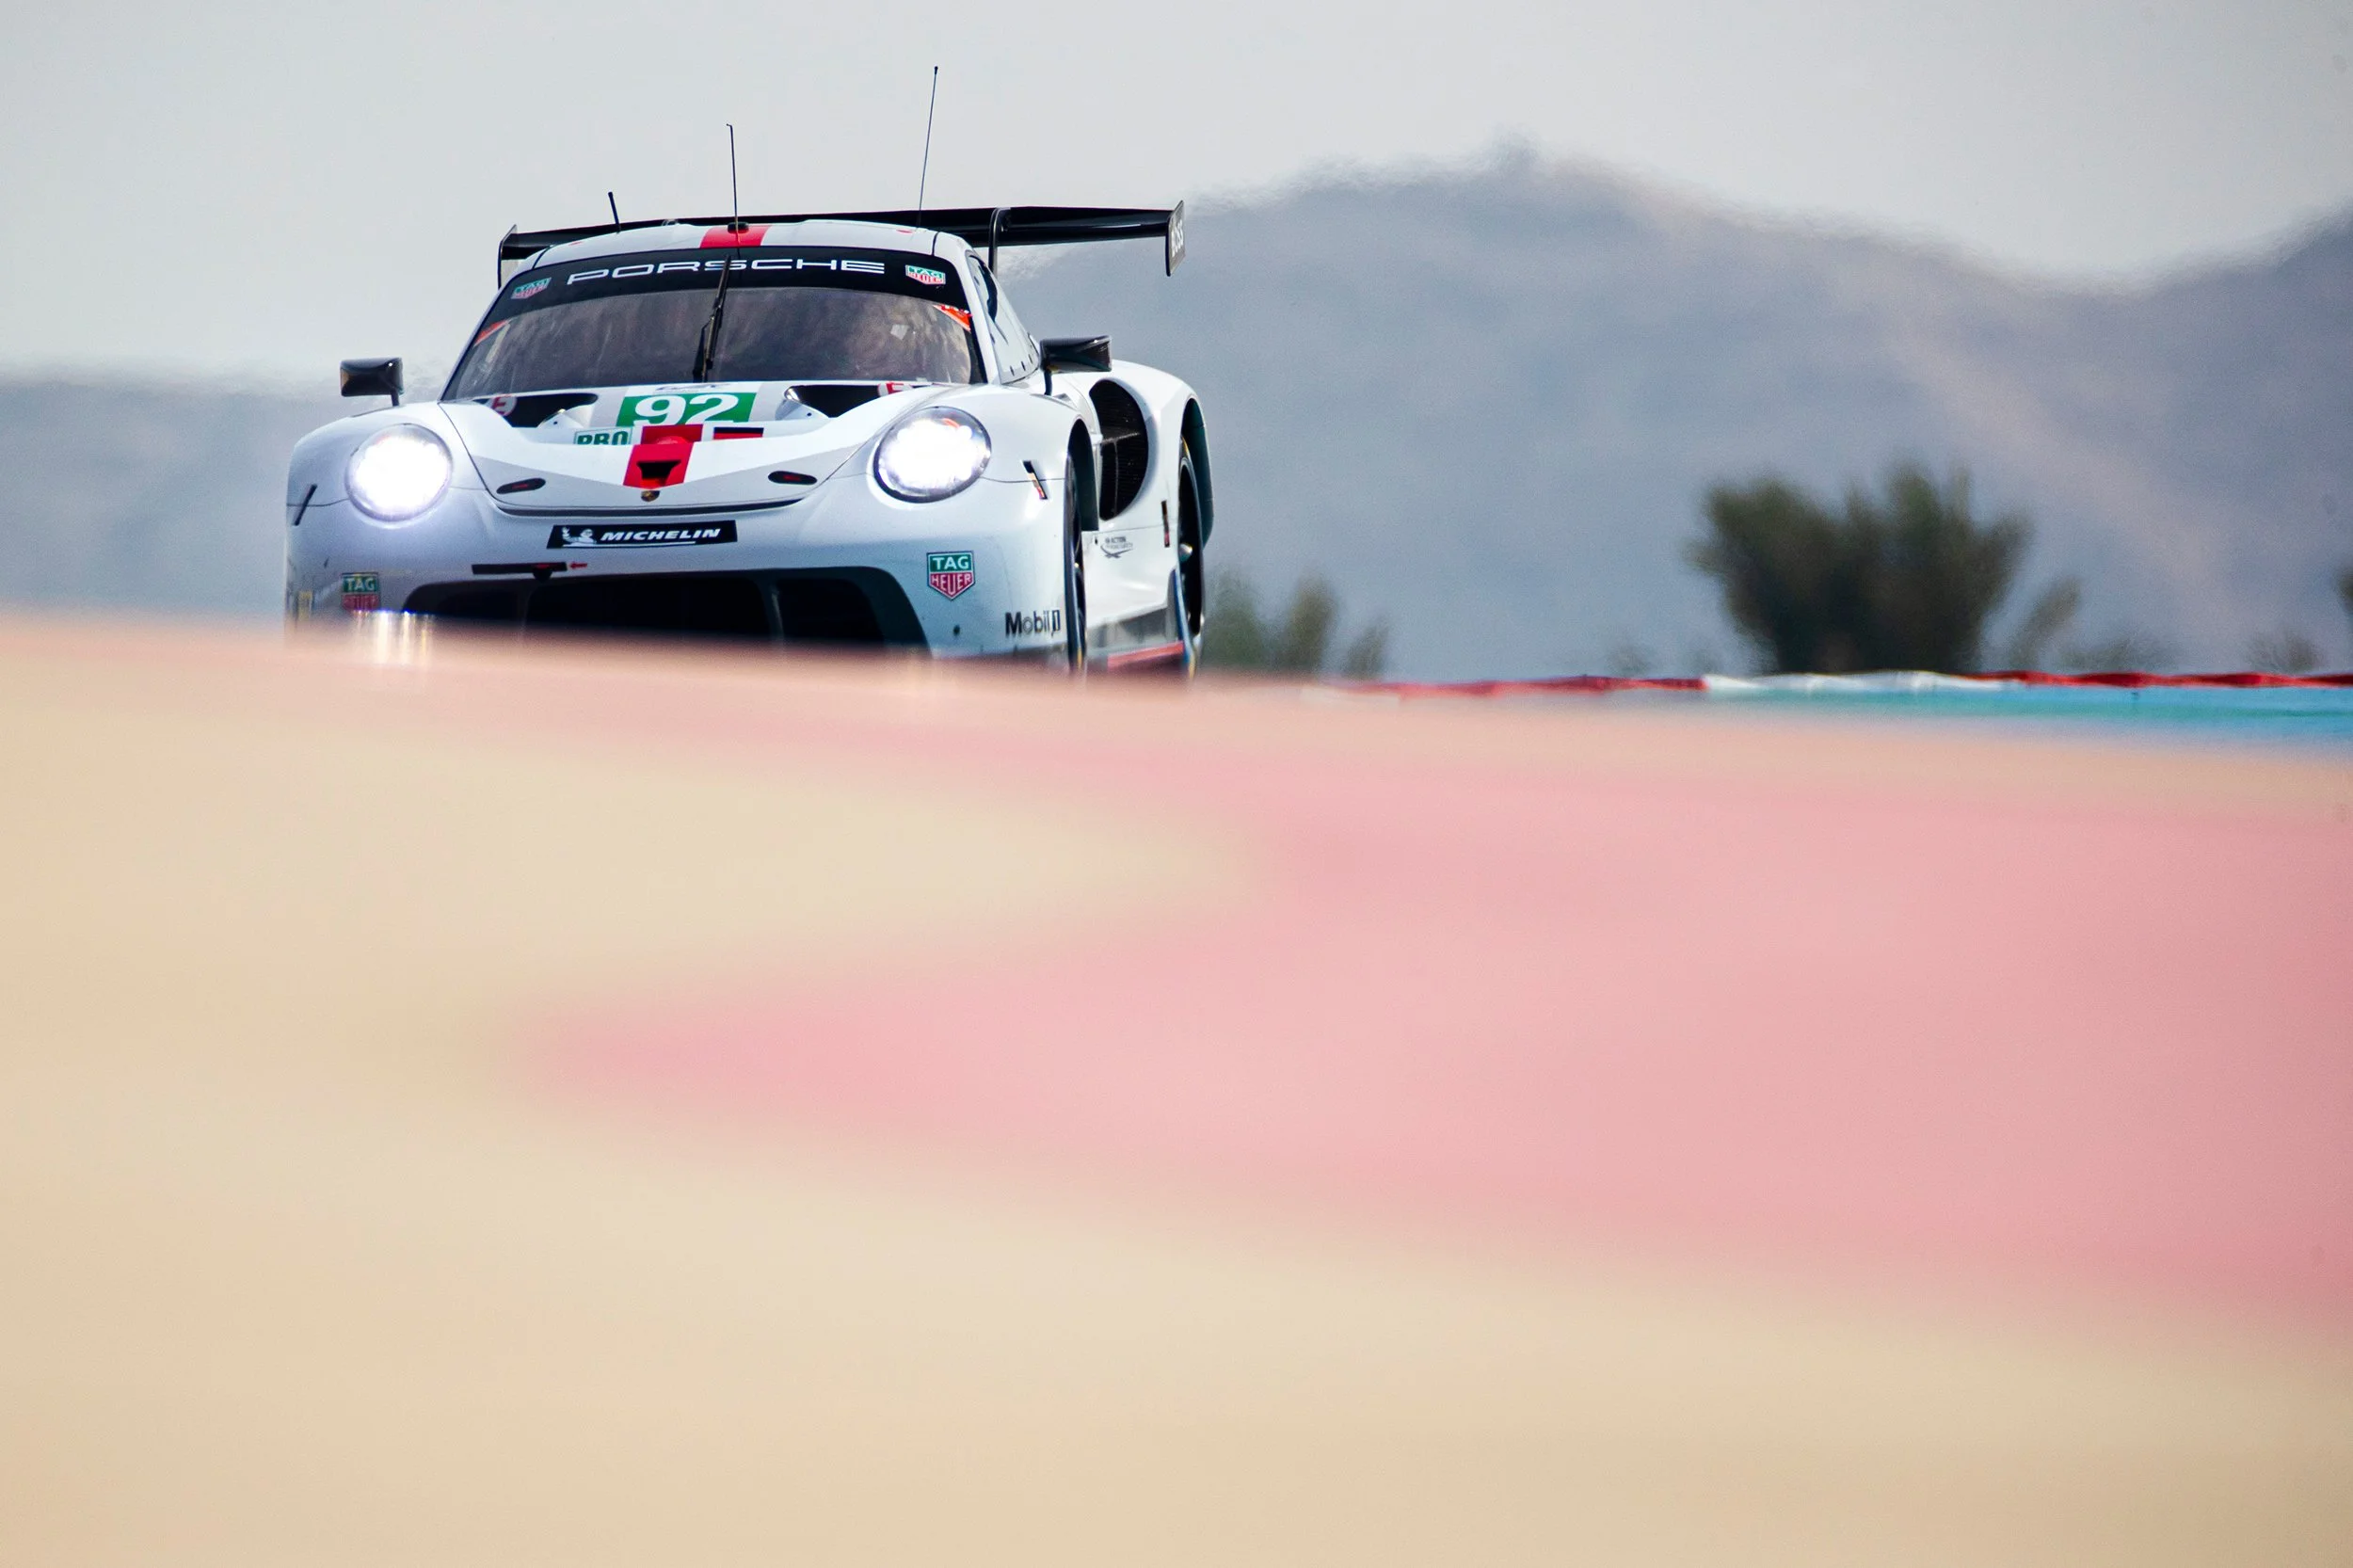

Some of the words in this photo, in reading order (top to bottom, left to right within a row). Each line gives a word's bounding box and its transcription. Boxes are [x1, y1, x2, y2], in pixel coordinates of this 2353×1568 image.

[567, 260, 885, 285] PORSCHE
[633, 394, 739, 425] 92
[577, 431, 629, 445] PRO
[600, 528, 721, 541] MICHELIN
[932, 556, 969, 570] TAG
[345, 577, 375, 591] TAG
[931, 573, 971, 595] HEUER
[1005, 611, 1049, 635] Mobil
